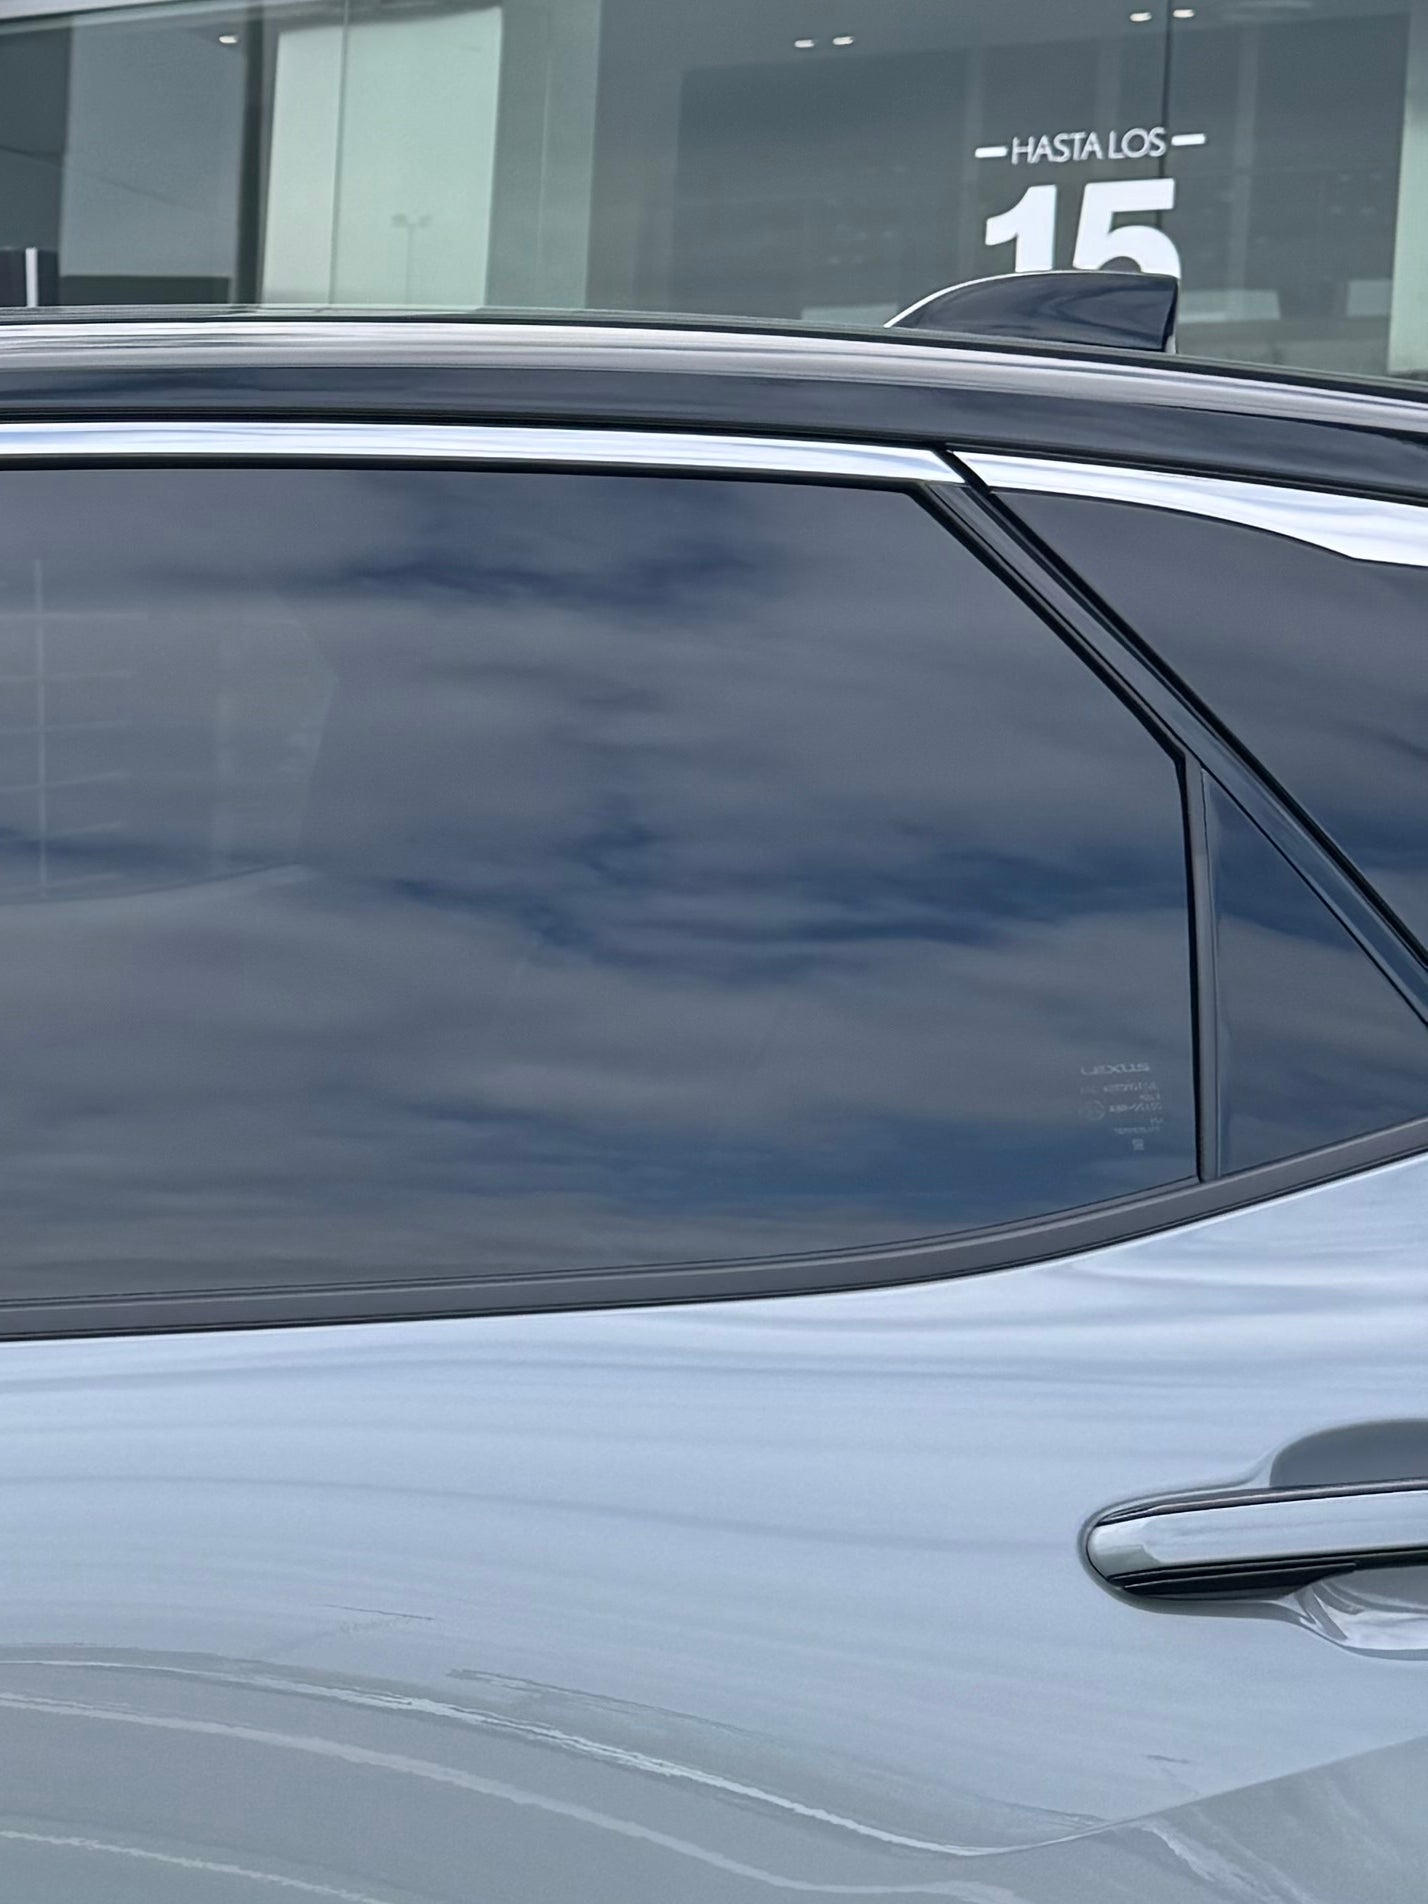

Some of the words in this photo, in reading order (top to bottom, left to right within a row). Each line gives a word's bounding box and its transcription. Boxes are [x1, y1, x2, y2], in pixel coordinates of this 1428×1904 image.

[1011, 132, 1102, 165] HASTA
[1108, 127, 1167, 160] LOS
[984, 178, 1182, 280] 15
